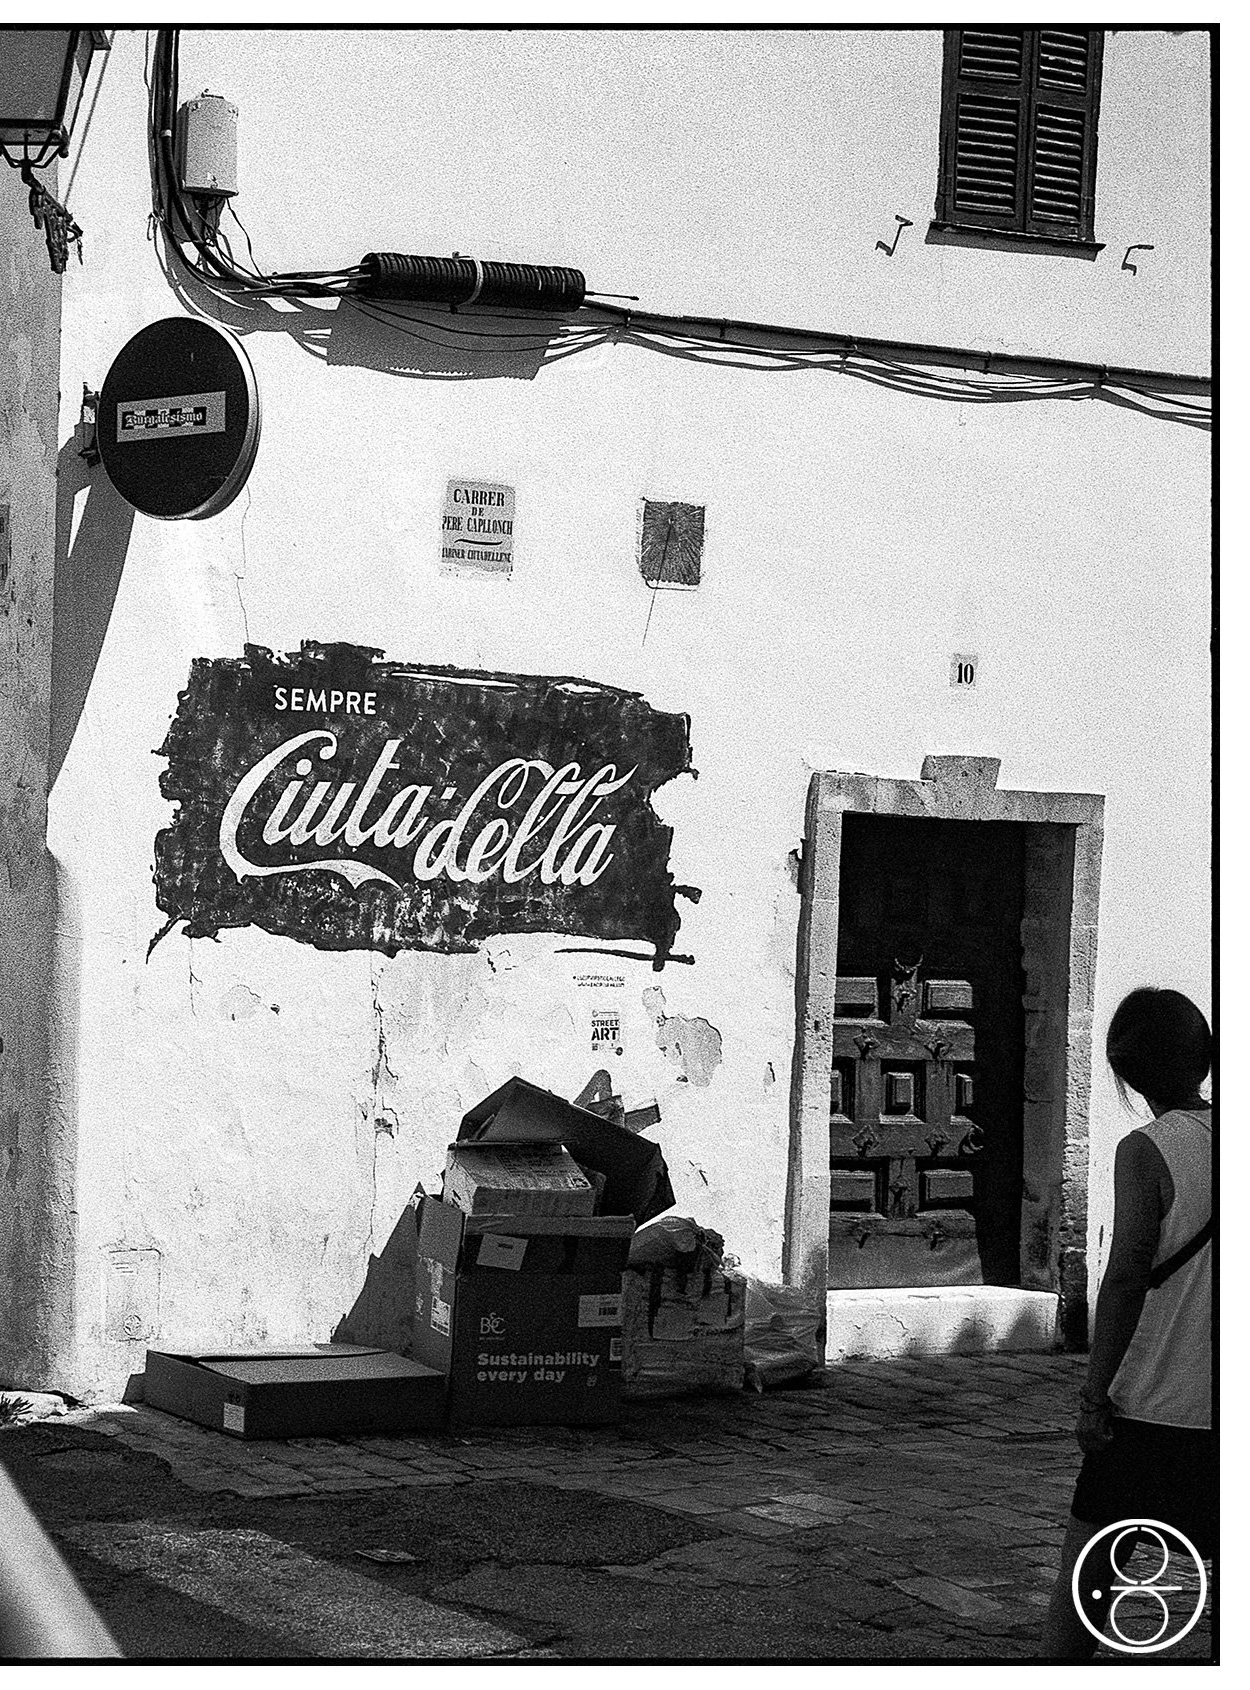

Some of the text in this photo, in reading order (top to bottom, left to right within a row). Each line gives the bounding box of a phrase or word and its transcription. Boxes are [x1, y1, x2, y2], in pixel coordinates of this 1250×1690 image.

[454, 489, 505, 507] CARRER
[471, 507, 485, 517] DE
[442, 516, 463, 531] PERE
[957, 662, 974, 684] 10
[275, 686, 377, 715] SEMPRE
[591, 1019, 620, 1027] STREET
[591, 1027, 620, 1041] ART
[477, 1352, 600, 1367] Sustainability
[477, 1368, 566, 1384] every day
